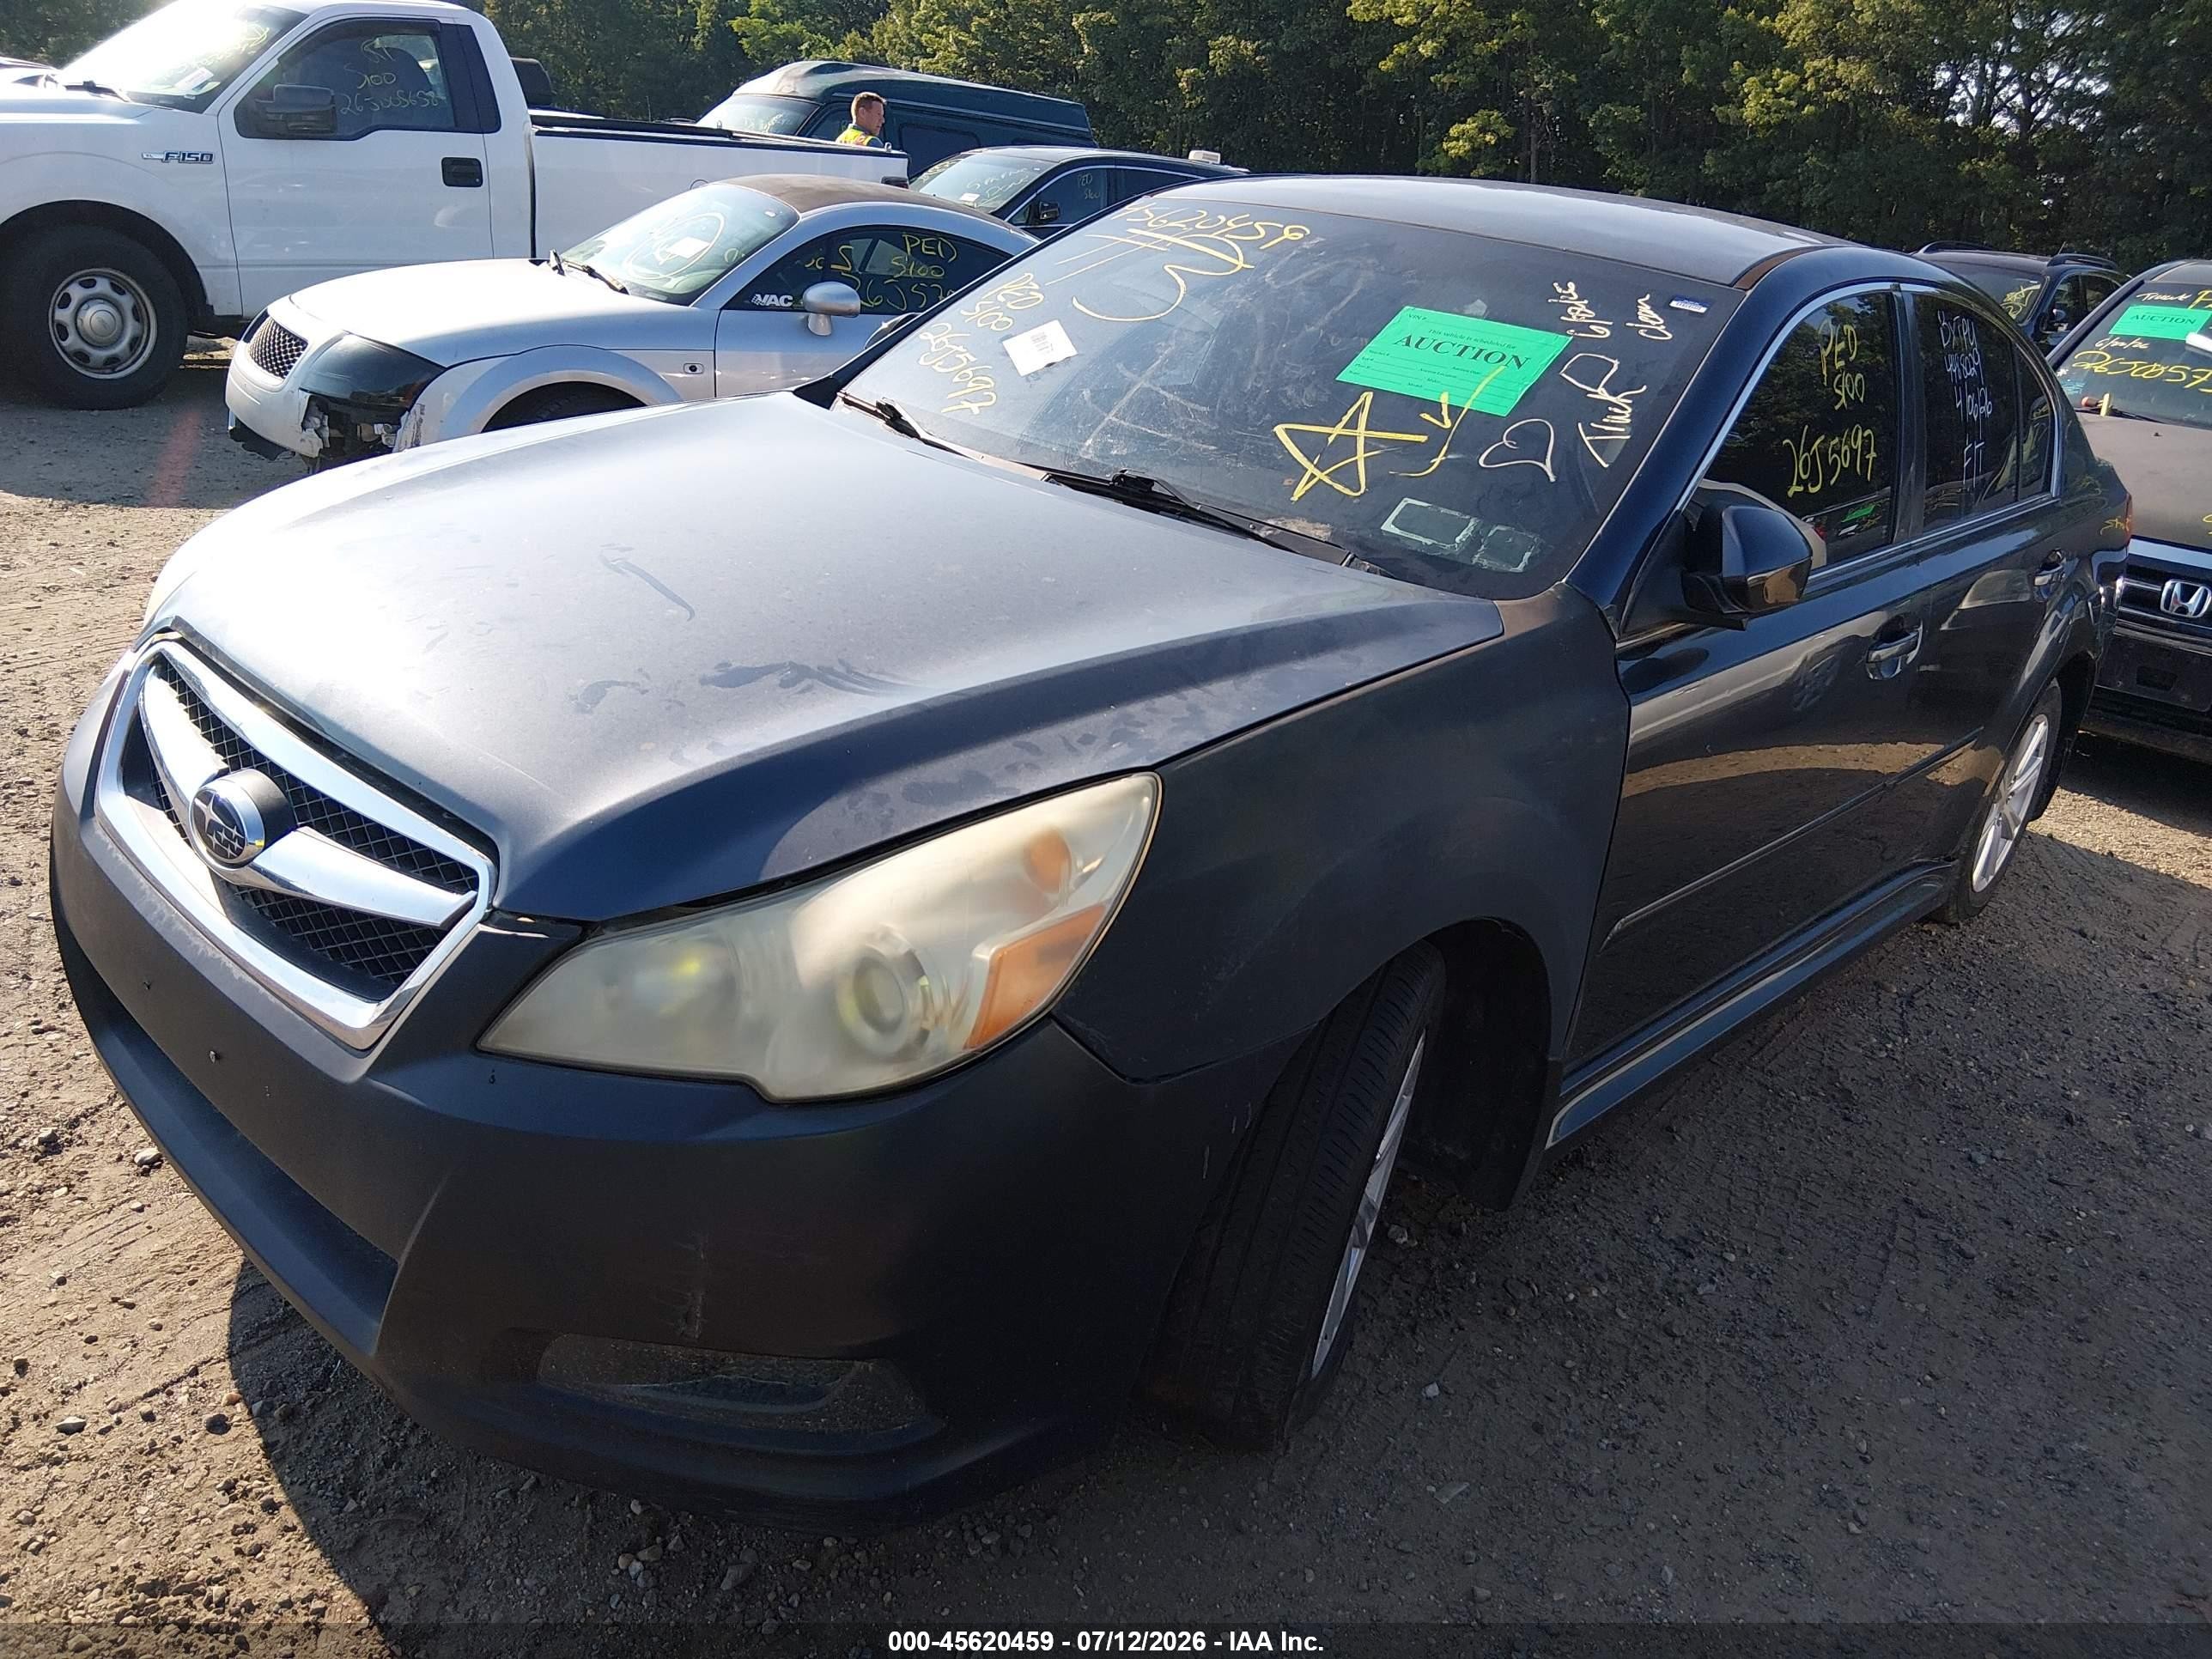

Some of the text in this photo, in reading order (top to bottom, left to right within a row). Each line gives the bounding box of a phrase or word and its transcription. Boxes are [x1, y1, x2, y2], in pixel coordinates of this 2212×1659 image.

[902, 234, 957, 263] PED
[2130, 314, 2197, 325] AUCTION
[1393, 334, 1530, 370] AUCTION
[1818, 318, 1857, 386] PED
[1782, 424, 1878, 498] 26J5697
